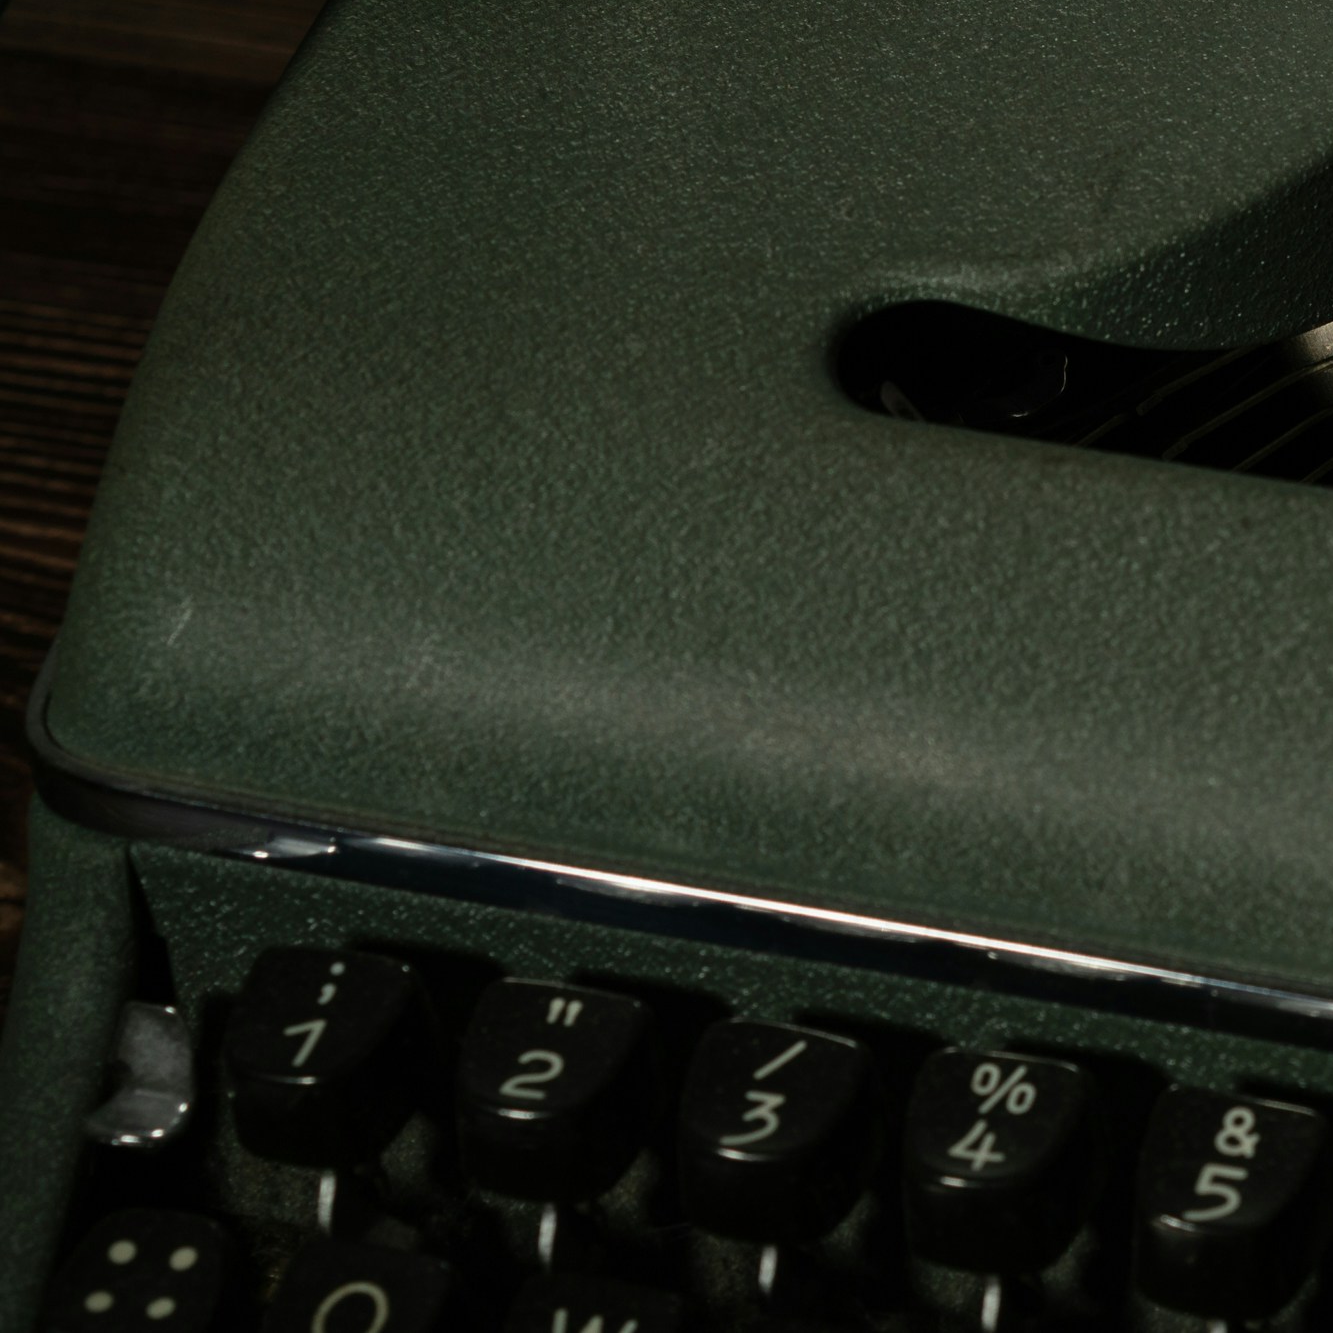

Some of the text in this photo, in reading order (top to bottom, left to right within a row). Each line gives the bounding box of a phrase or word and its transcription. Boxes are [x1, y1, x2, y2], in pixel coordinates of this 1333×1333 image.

[281, 1017, 329, 1068] 1
[498, 1048, 566, 1100] 2
[970, 1062, 1037, 1115] %
[718, 1090, 787, 1147] 3
[946, 1118, 1006, 1172] 4
[1213, 1105, 1262, 1159] &
[1182, 1162, 1250, 1223] 5
